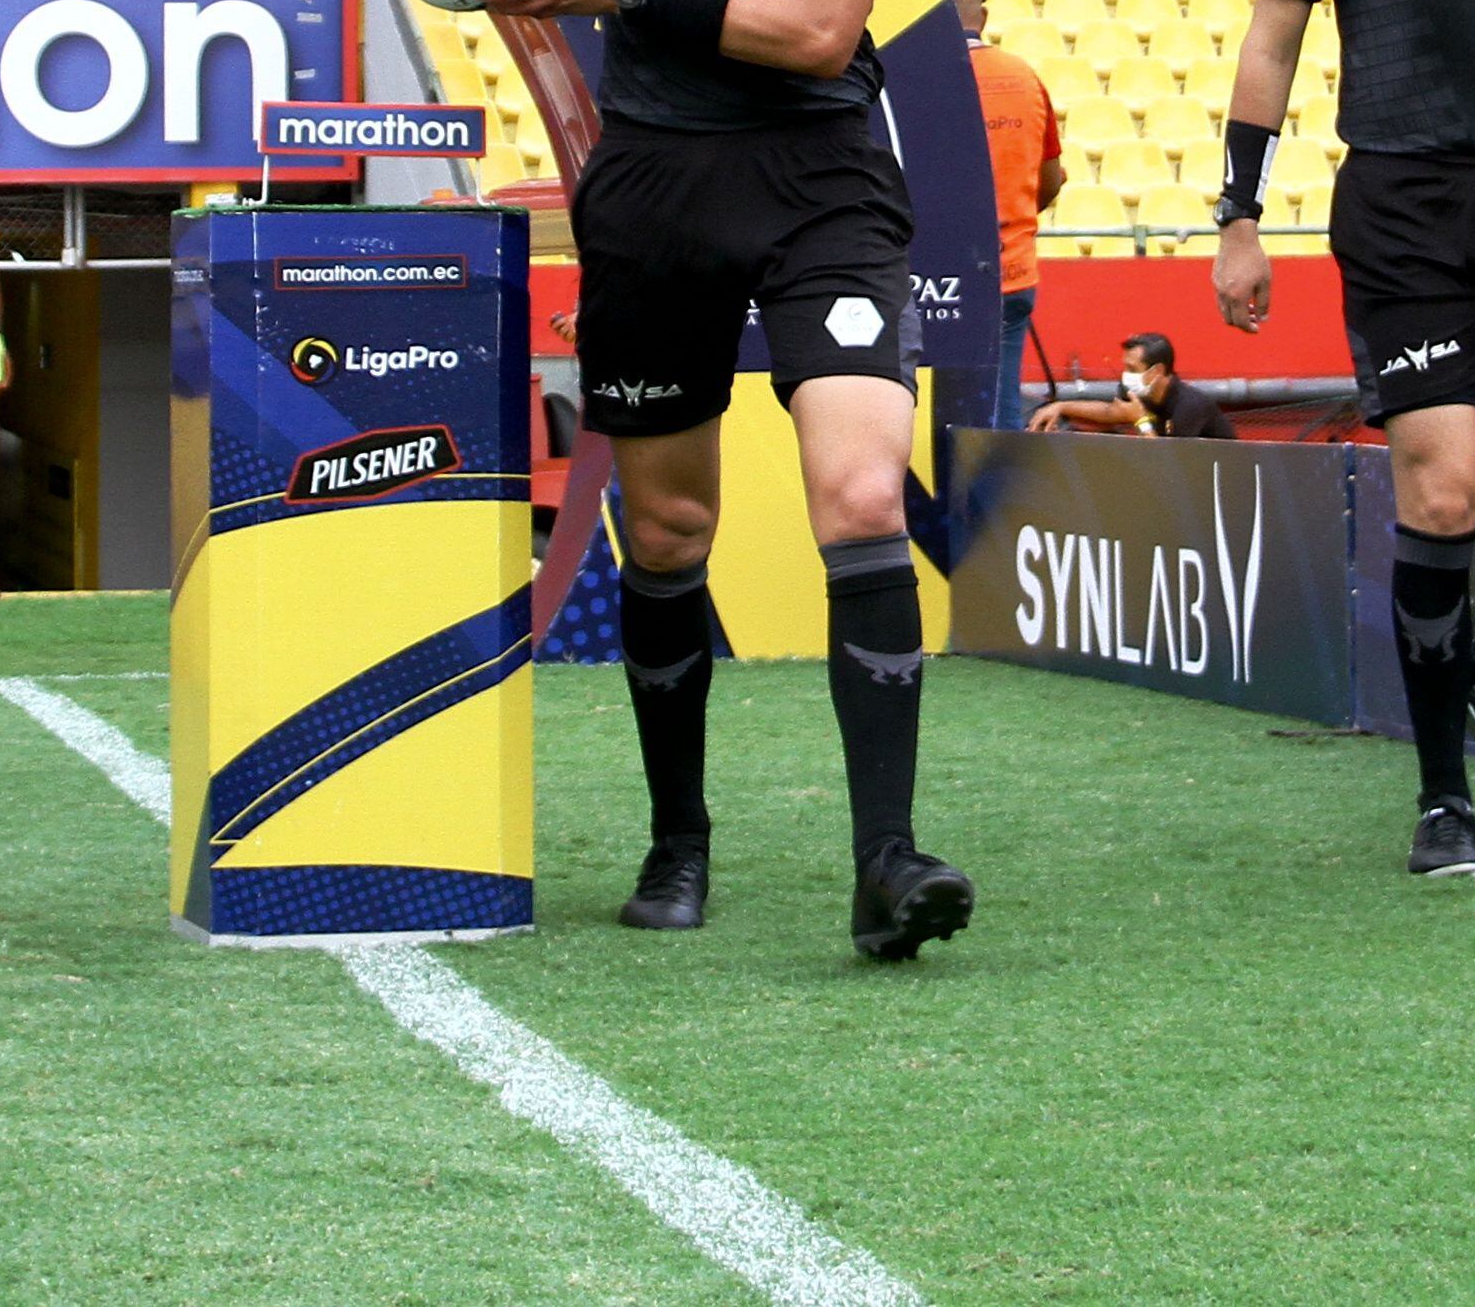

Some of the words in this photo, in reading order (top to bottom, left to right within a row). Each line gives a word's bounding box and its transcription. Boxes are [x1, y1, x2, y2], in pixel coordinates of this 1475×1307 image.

[278, 113, 469, 148] marathon
[282, 264, 460, 282] marathon.com.ec
[345, 345, 459, 377] LigaPro
[310, 436, 440, 494] PILSENER
[1015, 524, 1209, 675] SYNLAB
